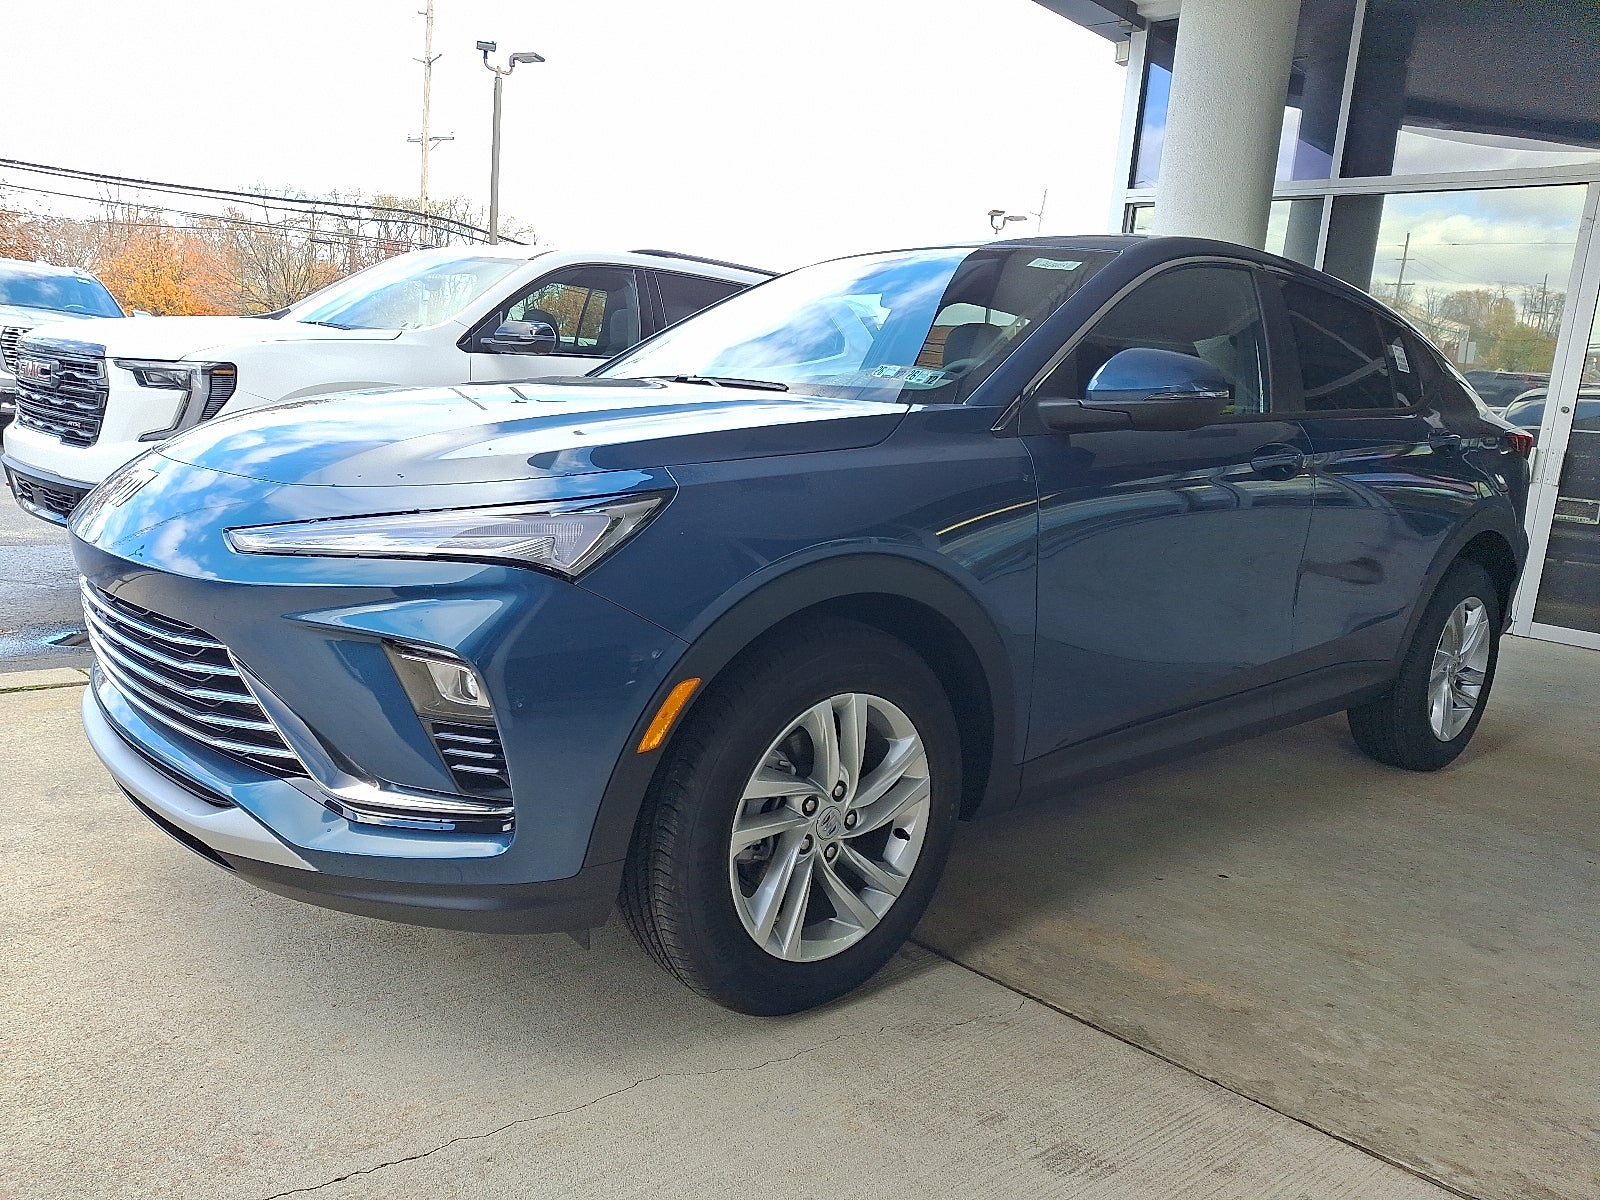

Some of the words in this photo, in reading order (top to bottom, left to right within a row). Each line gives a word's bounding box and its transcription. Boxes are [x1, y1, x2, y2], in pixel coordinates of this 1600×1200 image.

[20, 361, 50, 379] GMC
[904, 369, 920, 380] 26
[924, 375, 939, 385] 12
